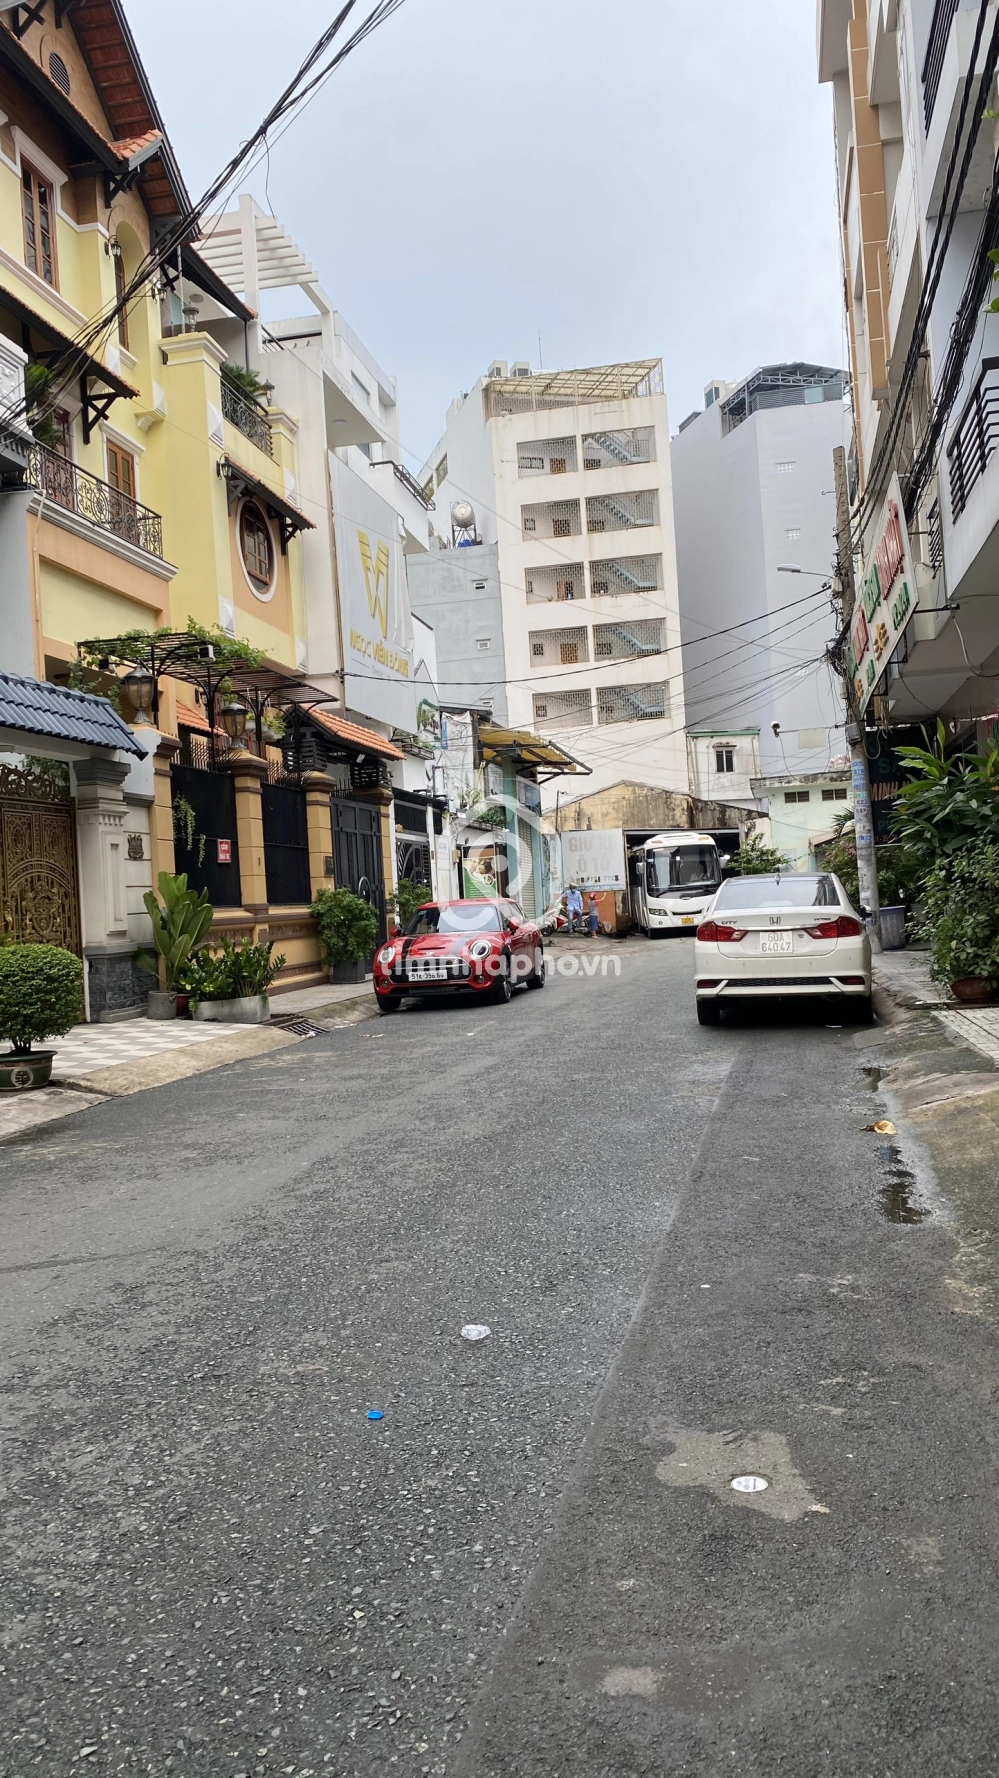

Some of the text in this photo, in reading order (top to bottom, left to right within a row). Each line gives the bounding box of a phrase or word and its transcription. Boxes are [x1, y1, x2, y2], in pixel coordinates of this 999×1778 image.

[578, 854, 587, 873] Ô
[767, 932, 785, 942] 60A
[761, 942, 791, 952] 640.47
